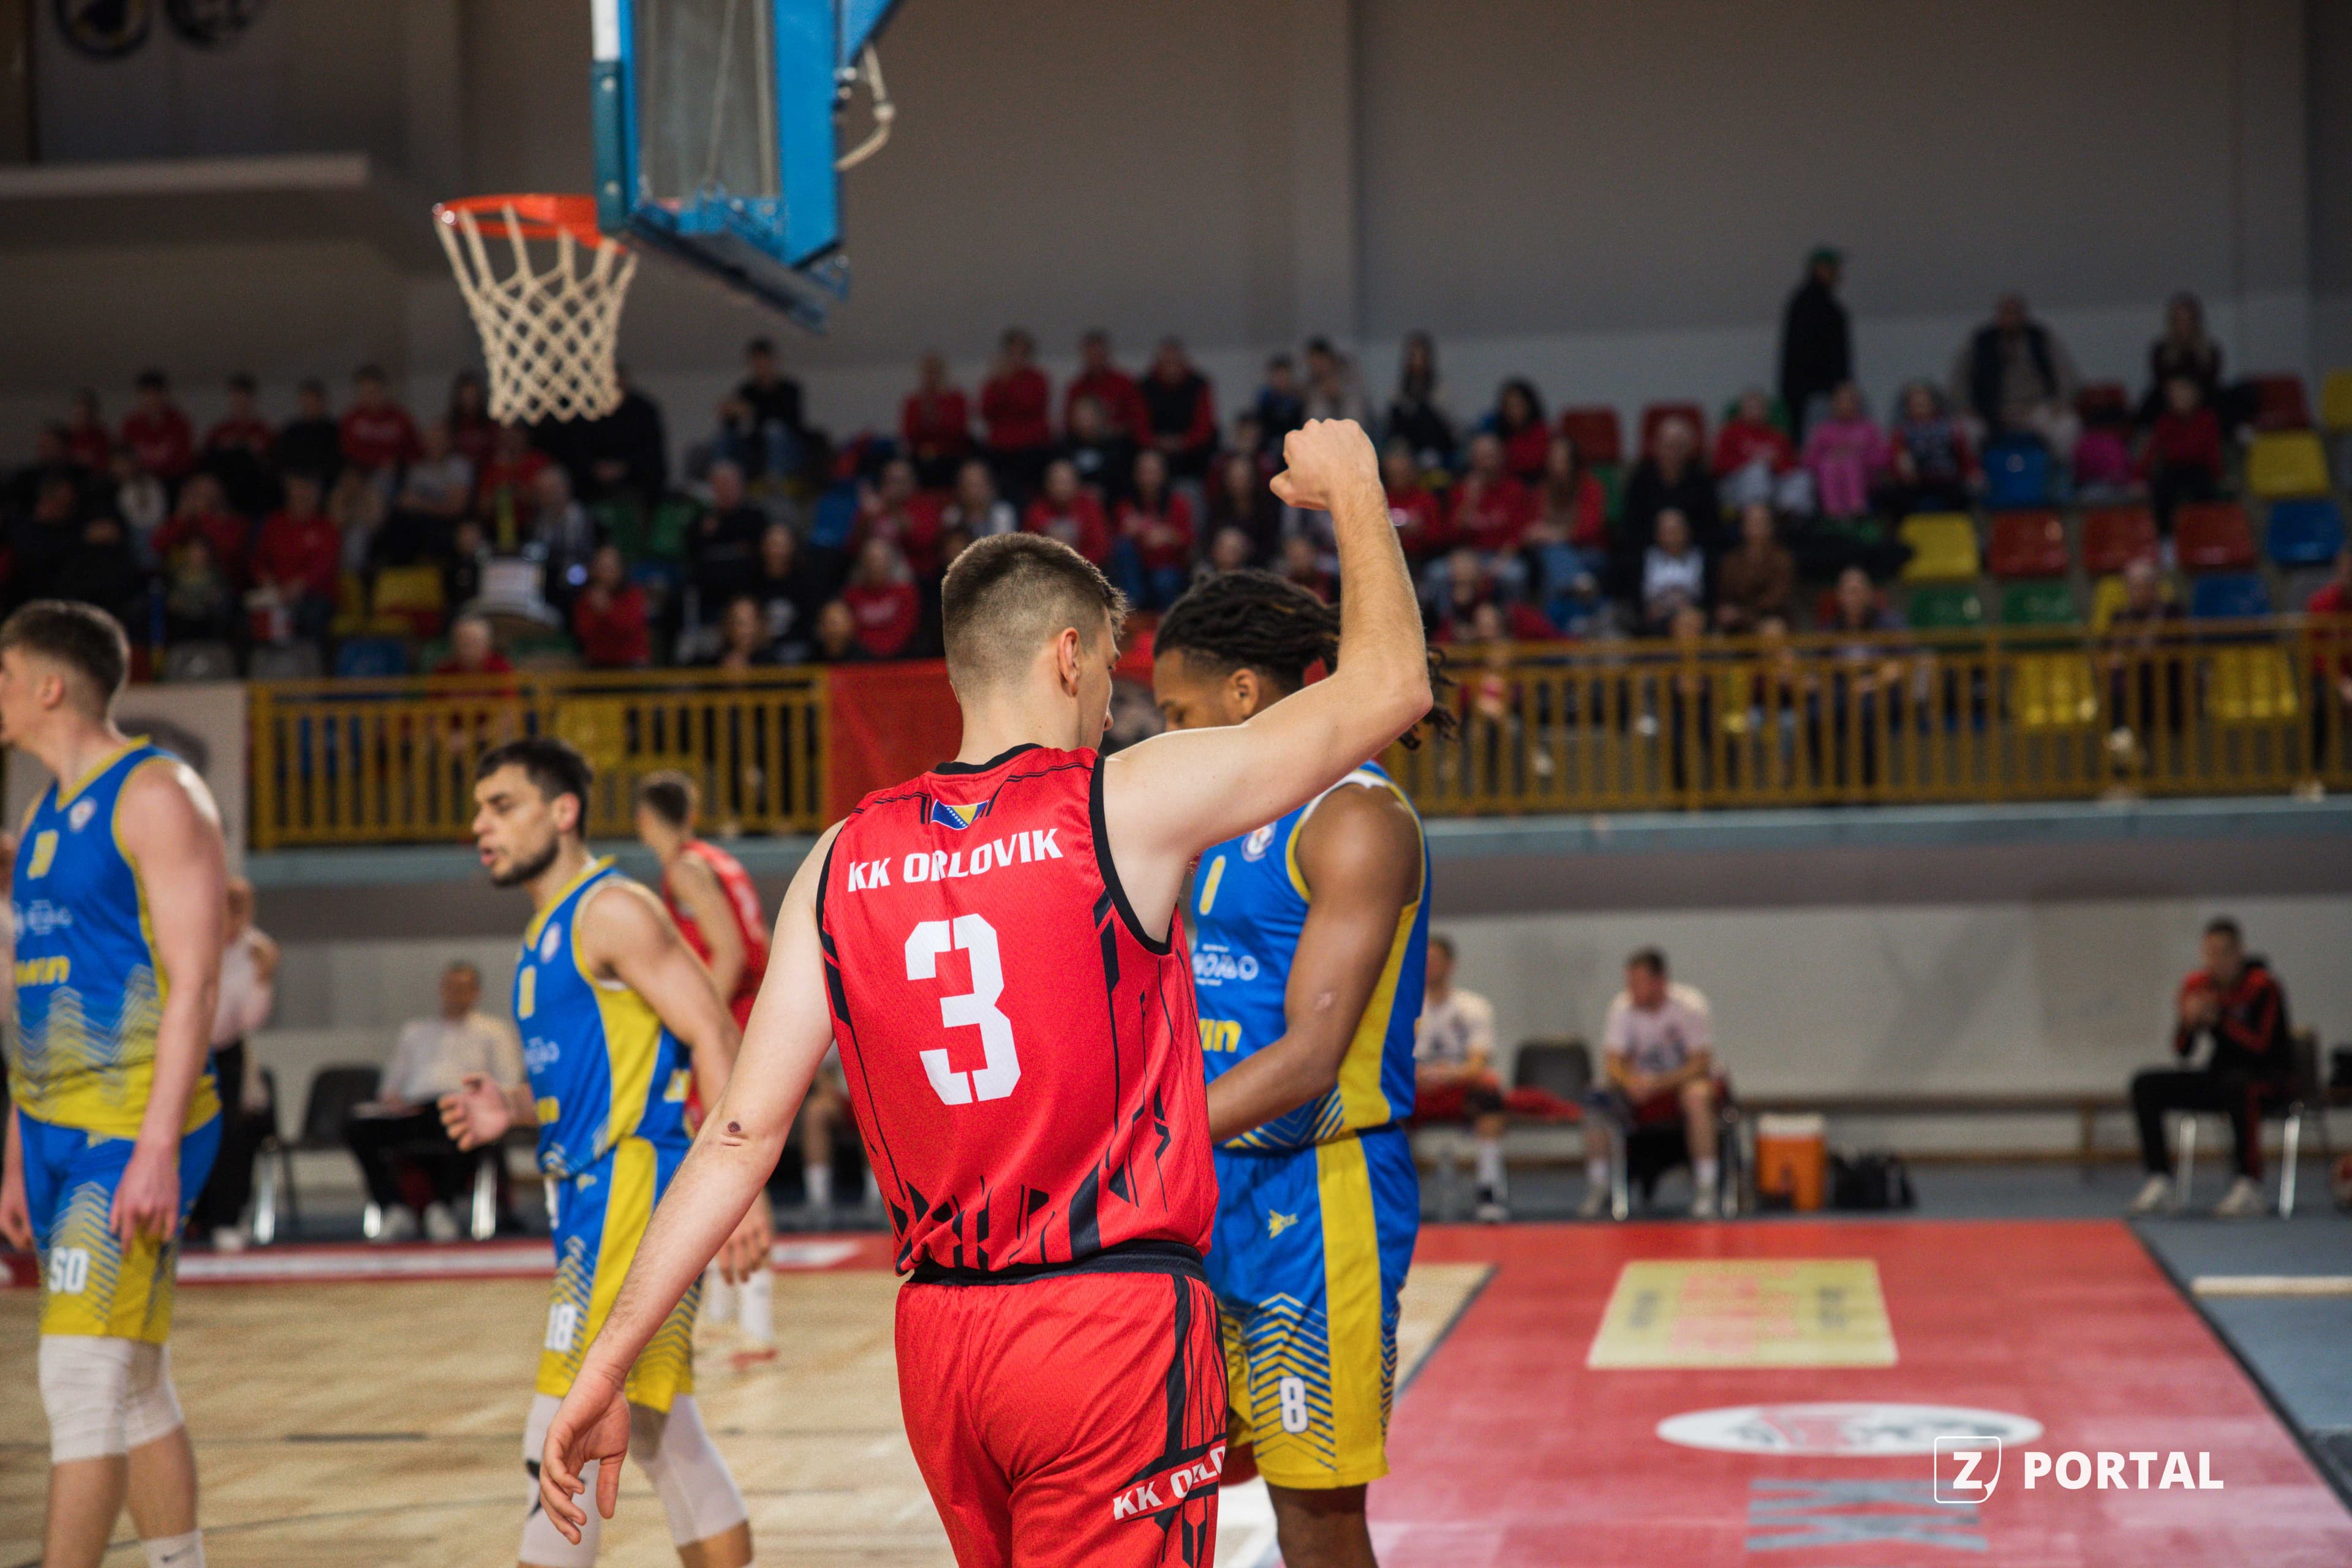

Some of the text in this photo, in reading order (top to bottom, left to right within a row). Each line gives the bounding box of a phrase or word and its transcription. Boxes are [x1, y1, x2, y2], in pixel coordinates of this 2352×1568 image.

[848, 828, 1063, 892] KK ORLOVIK
[905, 913, 1022, 1105] 3
[1280, 1376, 1309, 1433] 8
[1113, 1481, 1163, 1520] KK
